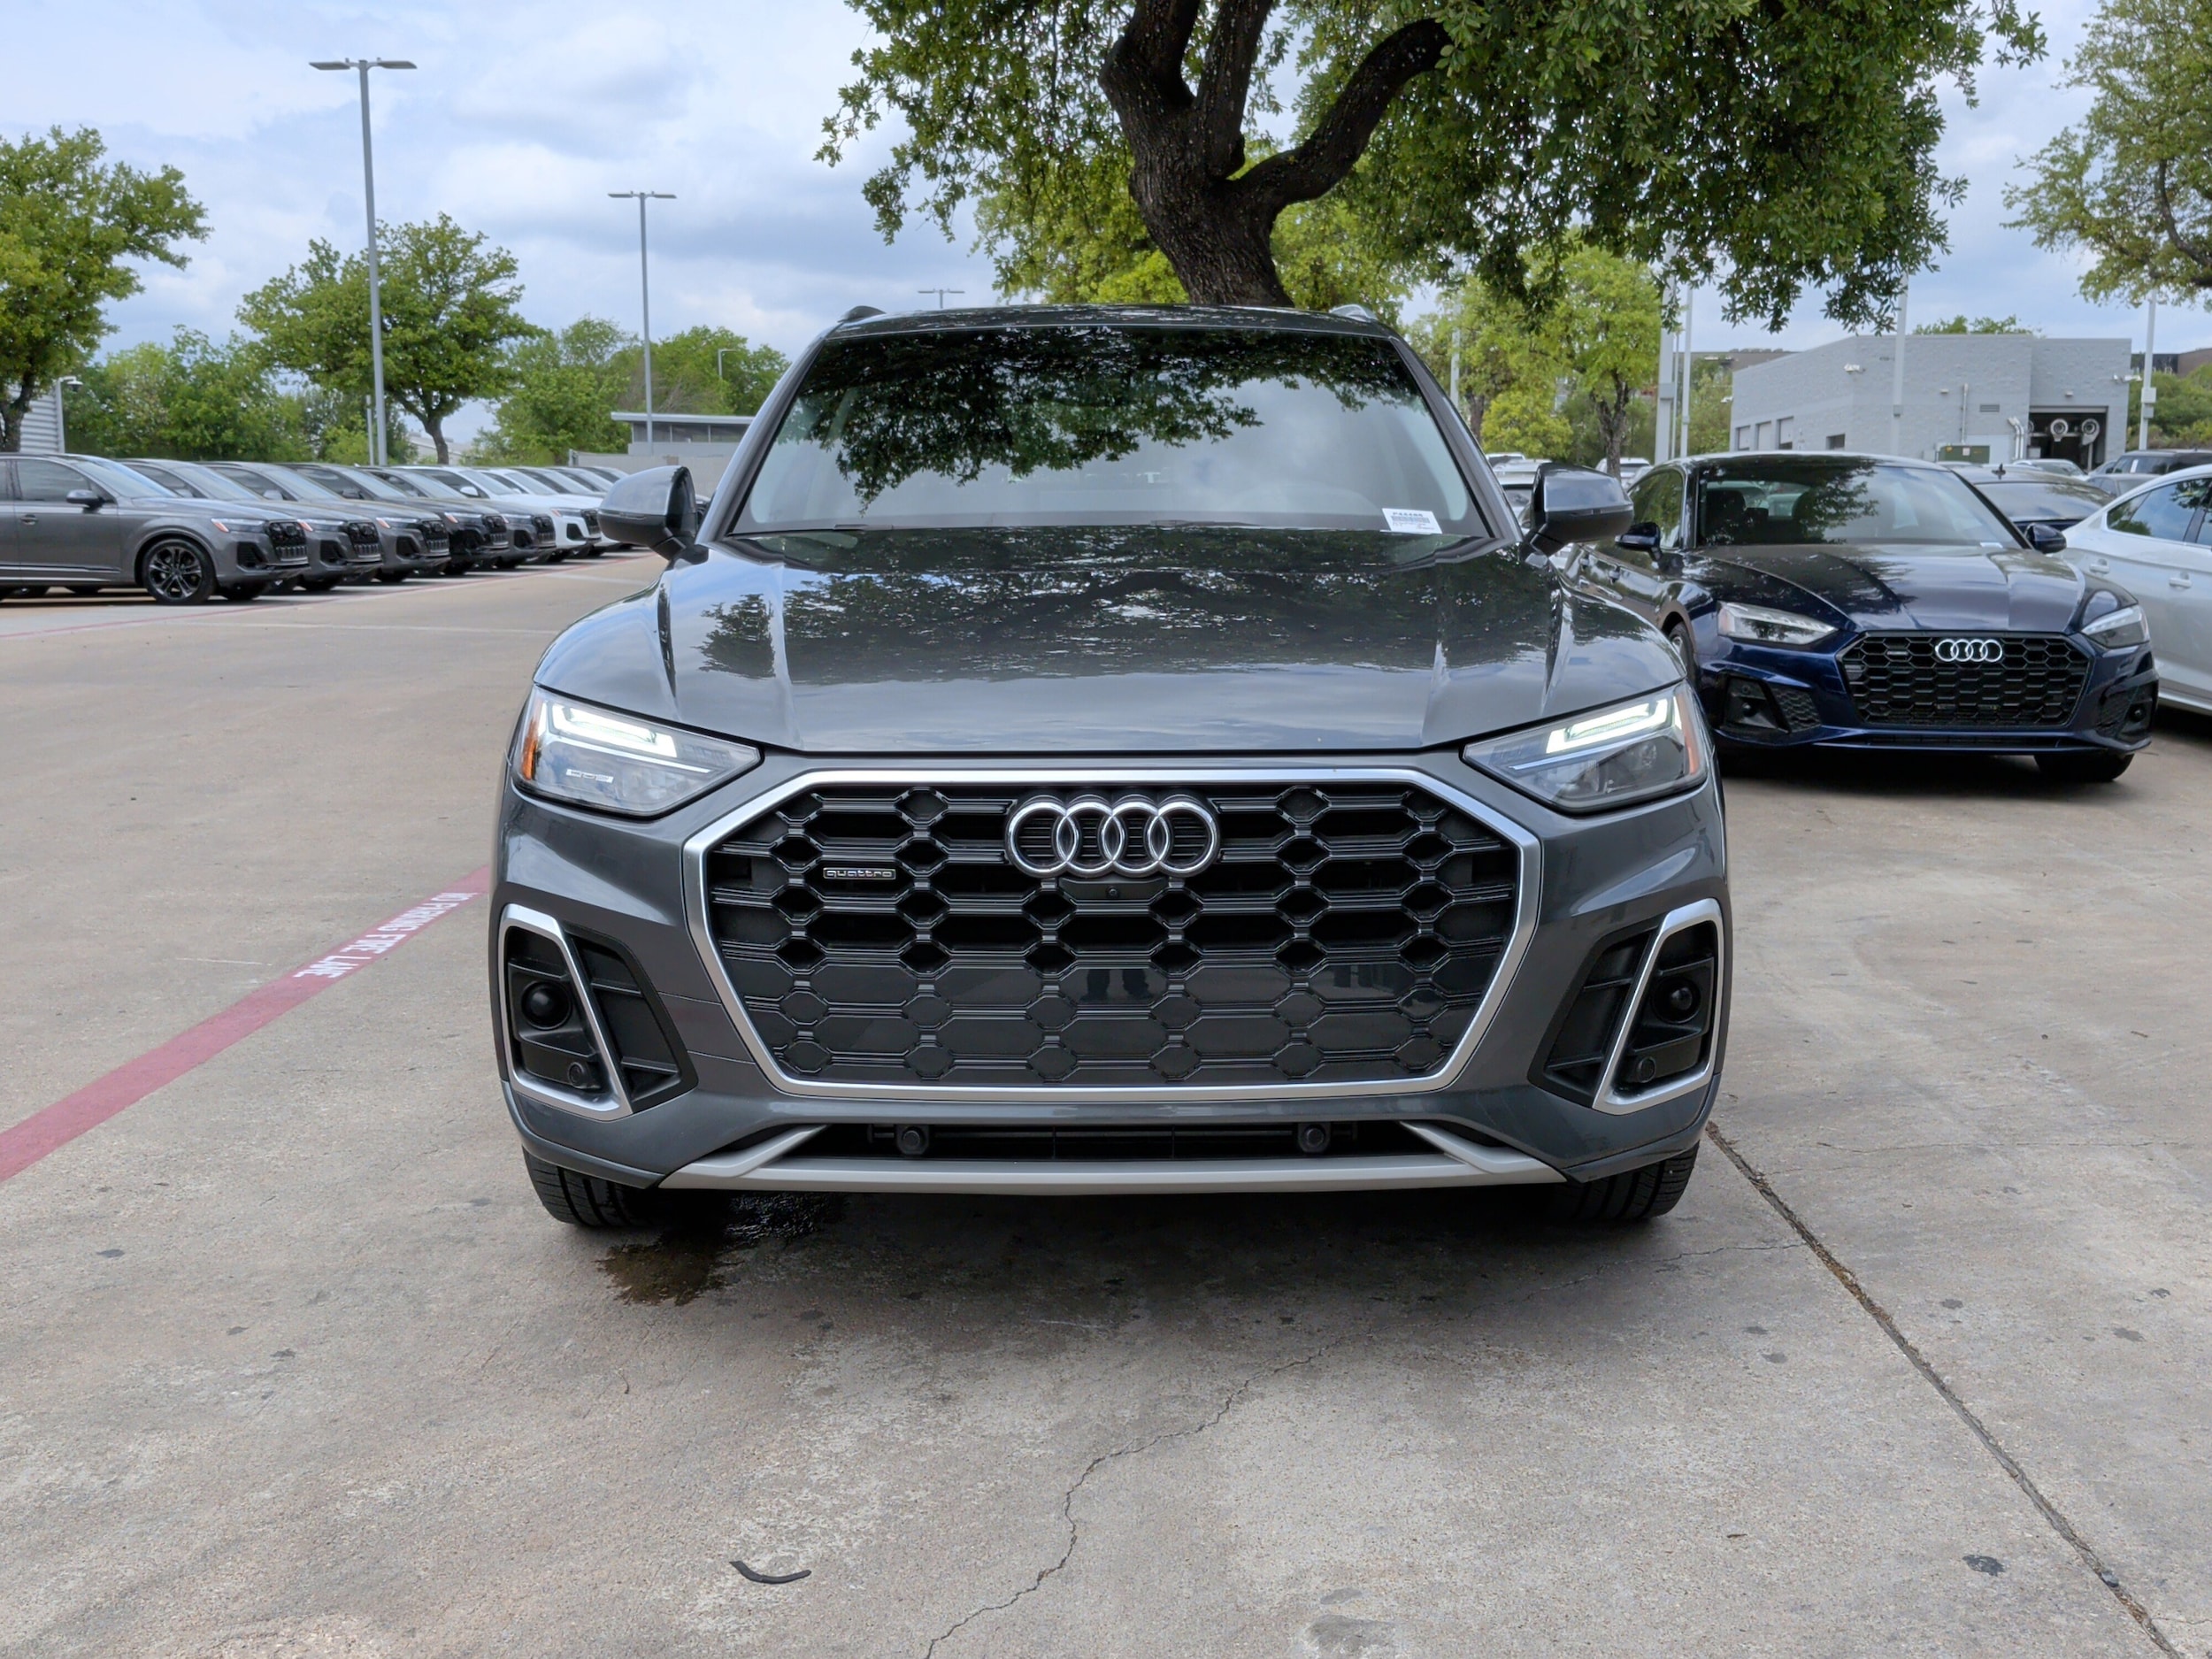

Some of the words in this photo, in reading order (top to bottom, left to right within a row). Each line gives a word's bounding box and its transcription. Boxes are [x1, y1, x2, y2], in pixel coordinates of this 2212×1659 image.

[826, 869, 894, 879] quattro
[339, 933, 407, 955] FIRE
[293, 955, 372, 978] LANE
